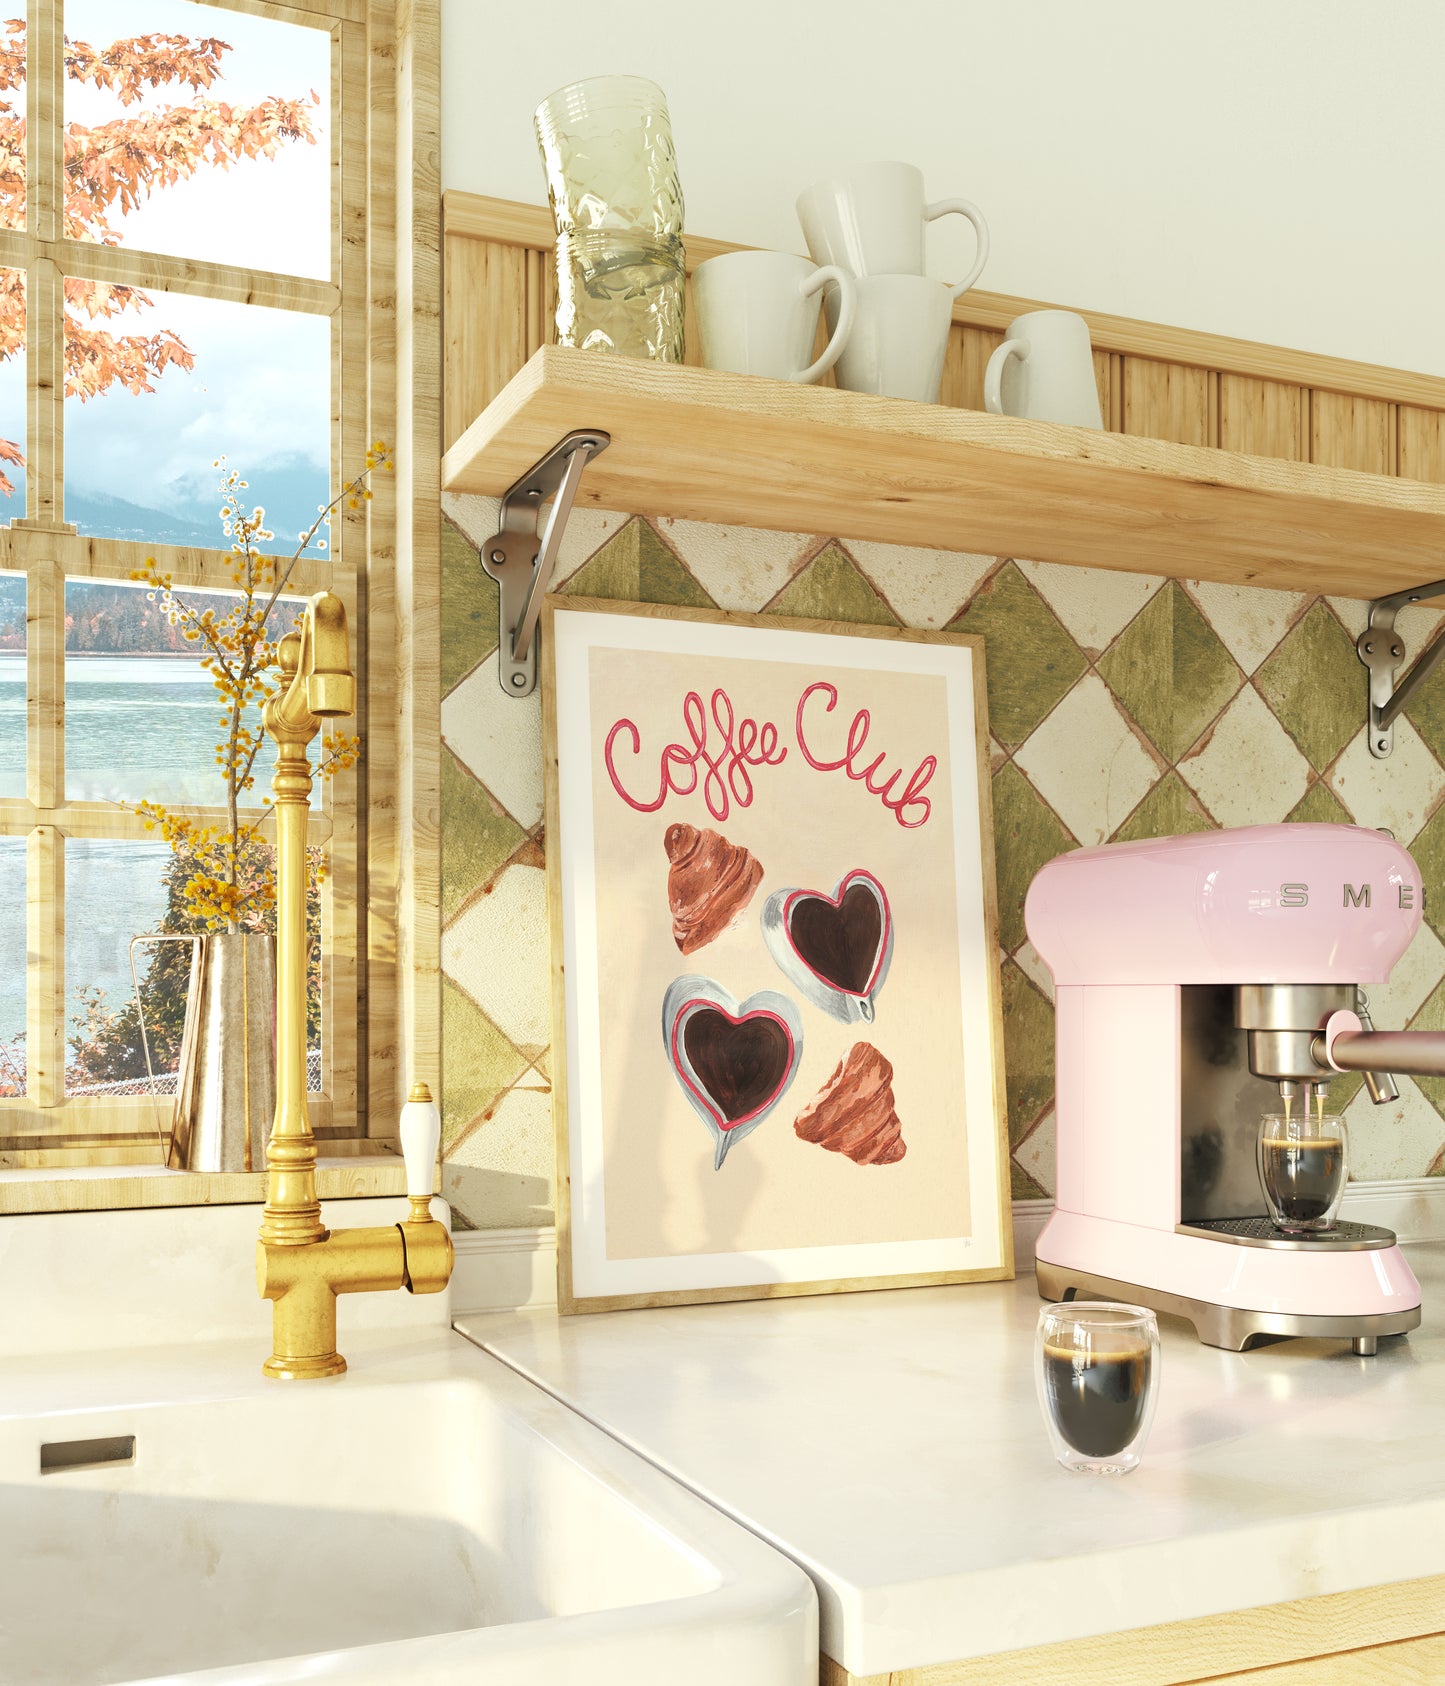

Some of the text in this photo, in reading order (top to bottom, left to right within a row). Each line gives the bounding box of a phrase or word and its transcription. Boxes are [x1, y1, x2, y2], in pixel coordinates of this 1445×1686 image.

[605, 682, 936, 828] Coffee Club
[1280, 883, 1427, 910] SME
